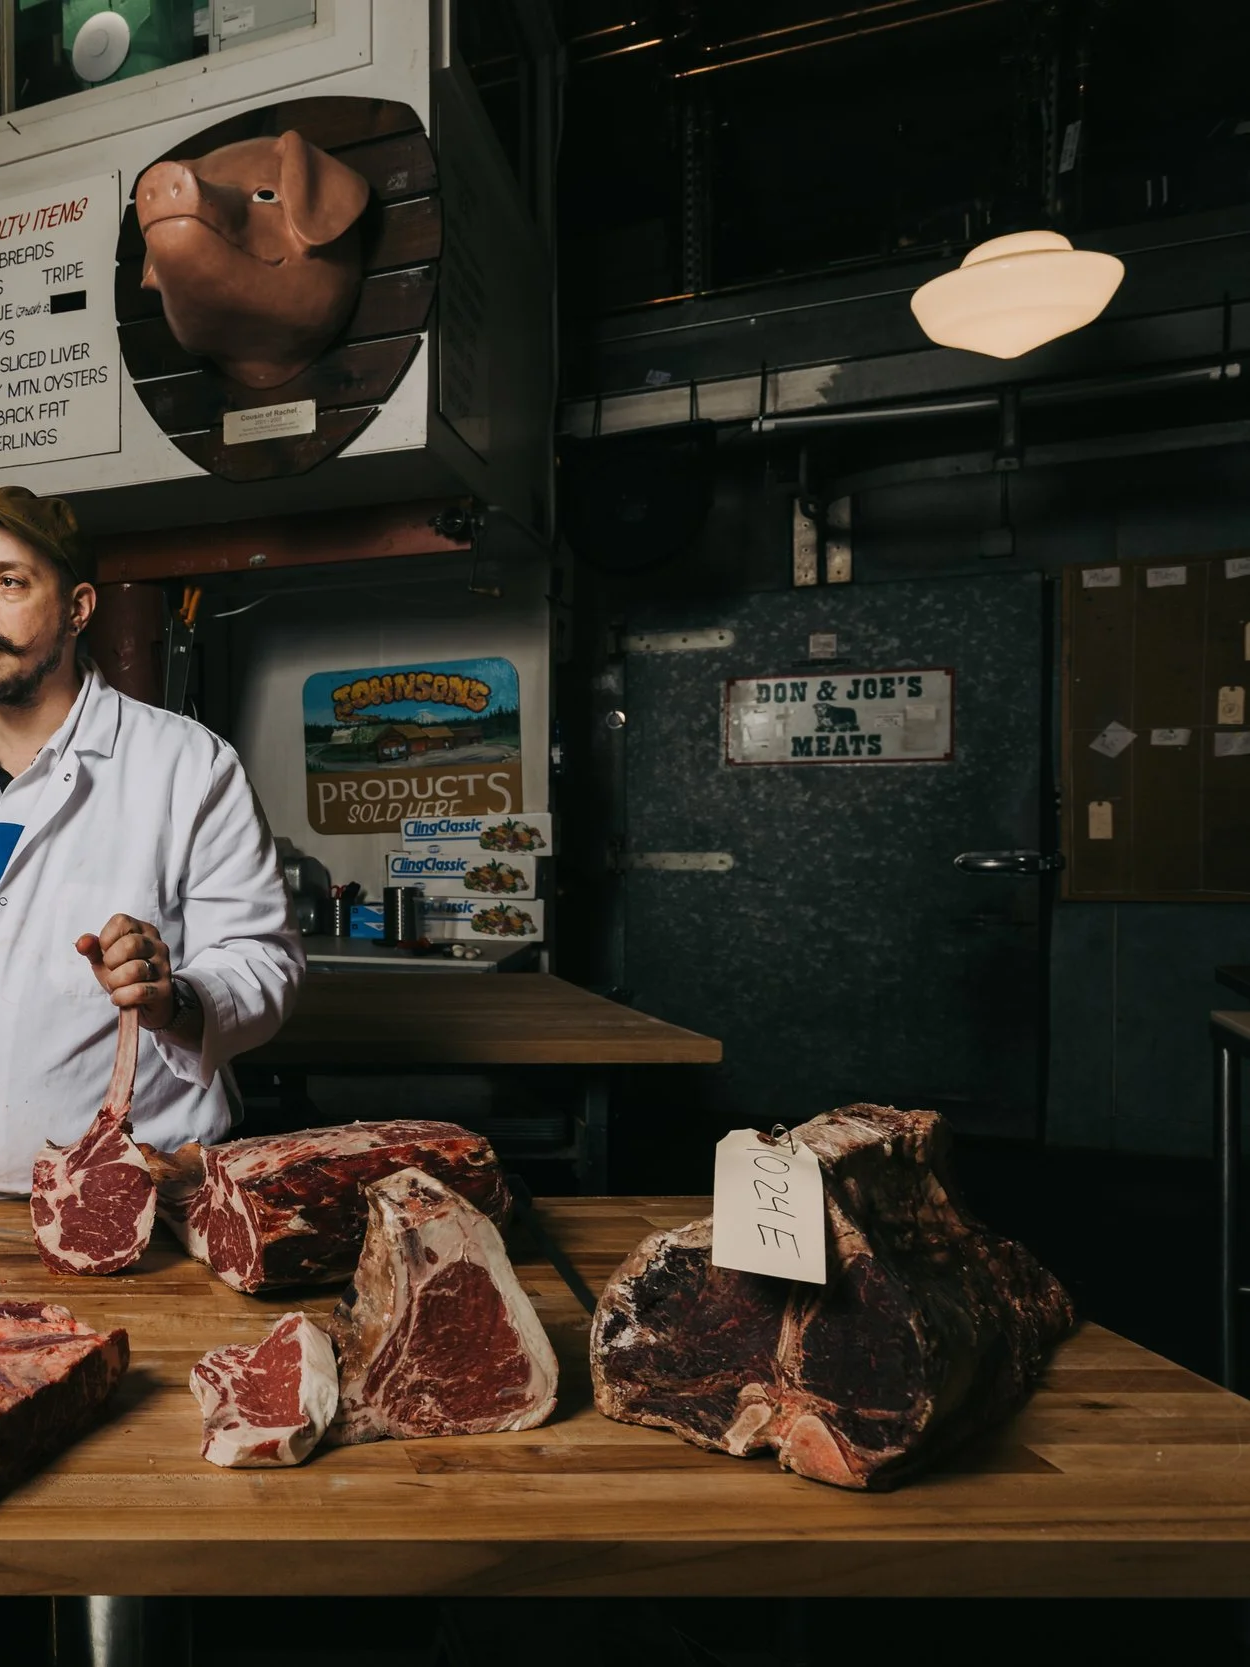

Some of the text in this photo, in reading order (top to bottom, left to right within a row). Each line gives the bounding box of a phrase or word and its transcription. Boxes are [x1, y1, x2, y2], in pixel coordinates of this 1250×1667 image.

[33, 197, 88, 232] ITEMS
[42, 262, 84, 285] TRIPE
[0, 351, 46, 373] SLICED
[50, 342, 90, 365] LIVER
[8, 378, 42, 398] MTN.
[44, 366, 108, 392] OYSTERS
[39, 400, 70, 420] FAT
[240, 413, 264, 422] Cousin
[274, 407, 297, 416] Rachel
[756, 676, 922, 704] DON & JOE'S
[792, 734, 882, 757] MEATS
[317, 772, 513, 825] PRODUCTS
[348, 803, 403, 824] SOLD
[404, 818, 482, 837] ClingClassic
[391, 858, 467, 874] ClingClassic
[746, 1148, 800, 1258] 1024E
